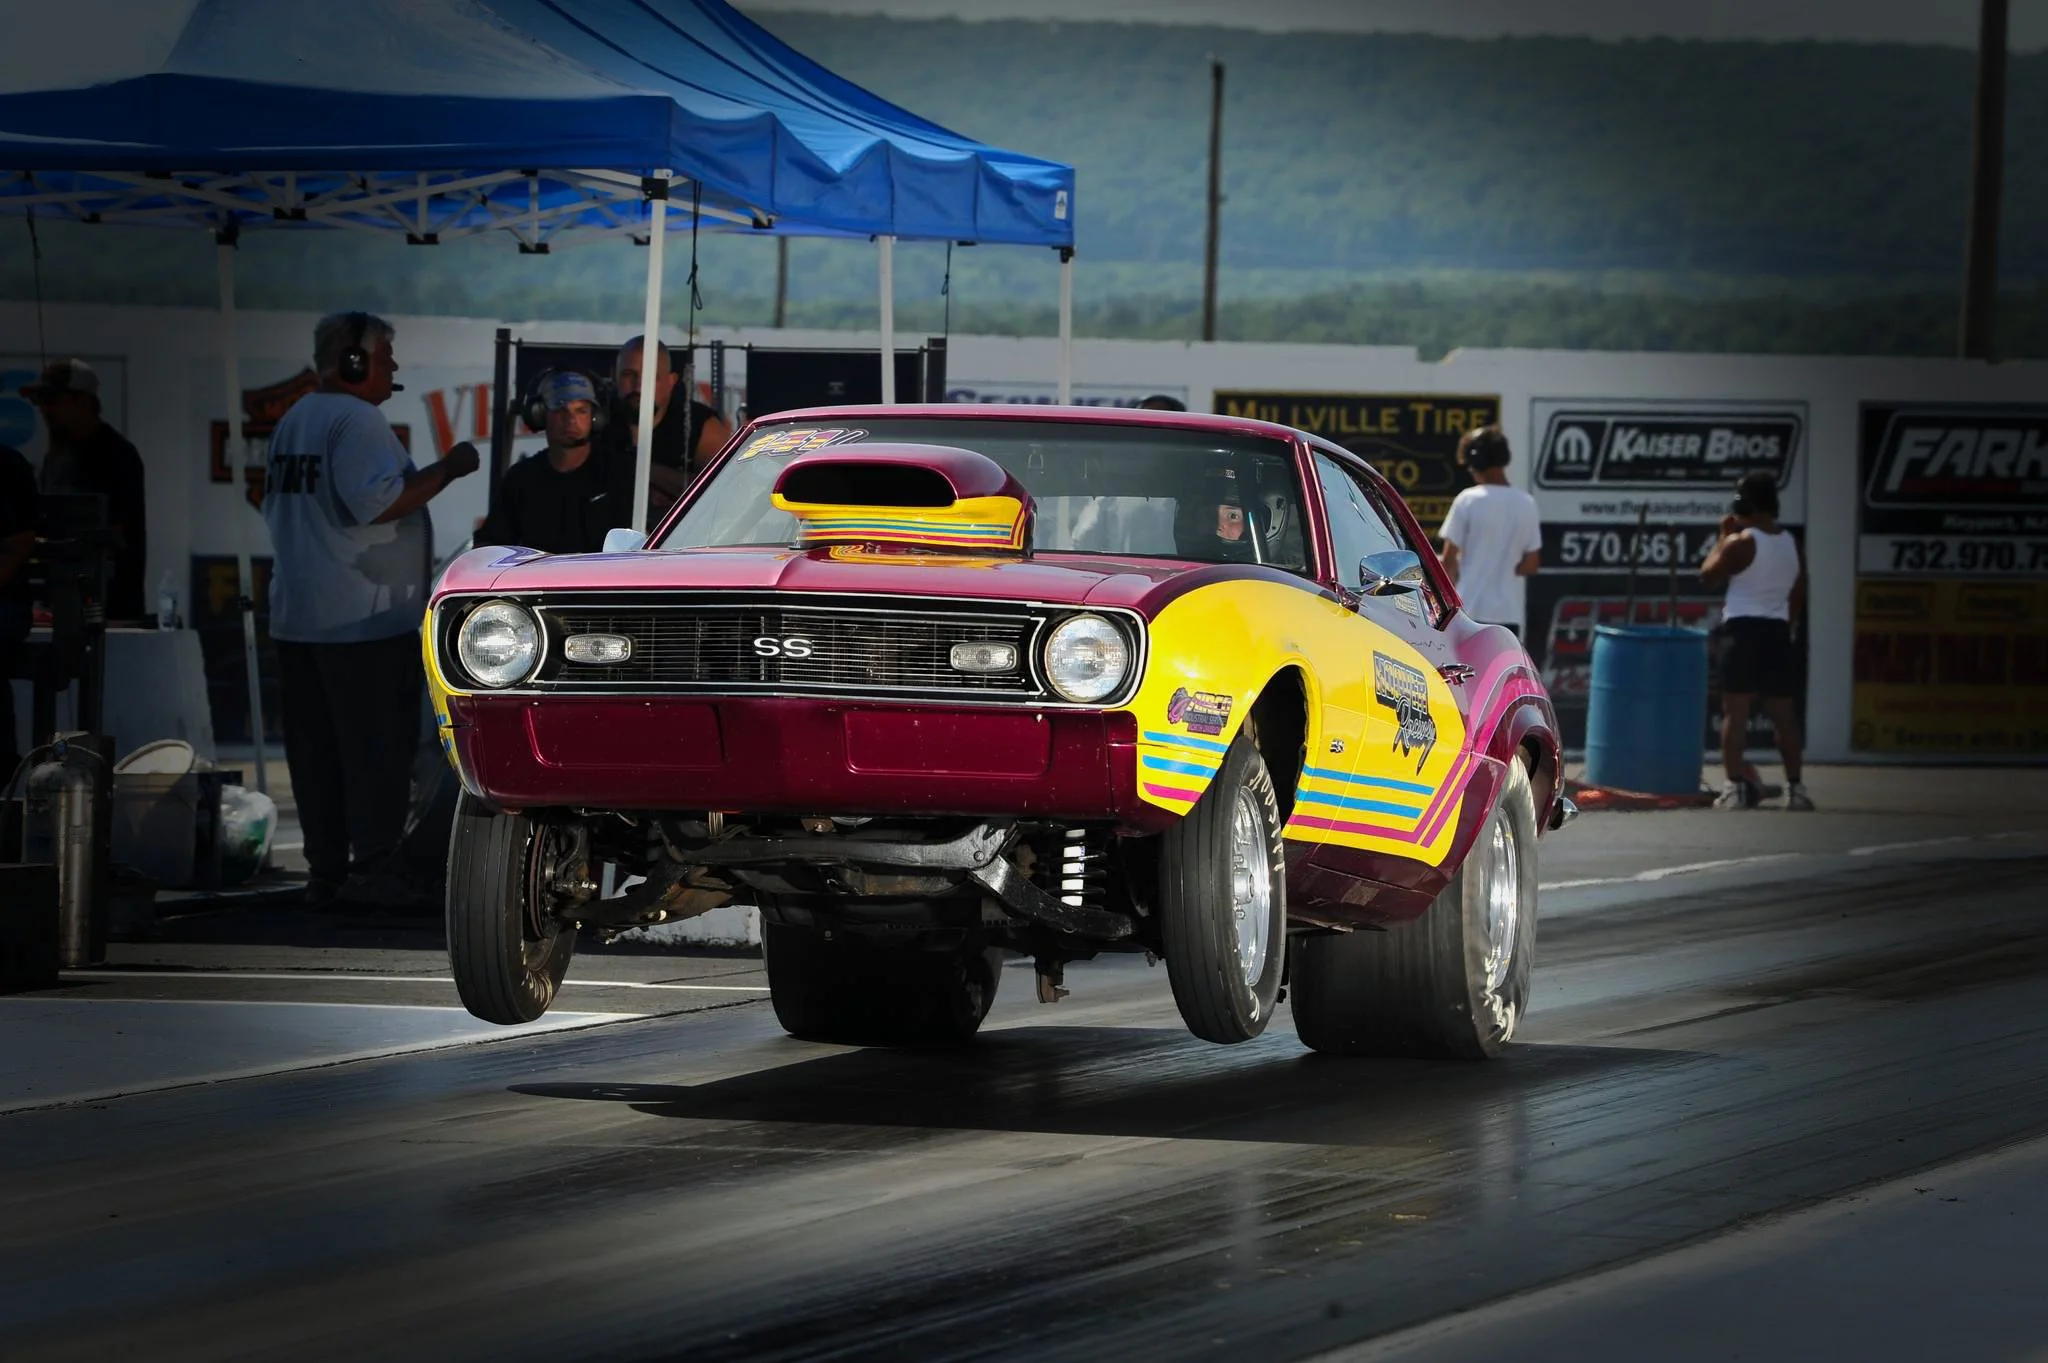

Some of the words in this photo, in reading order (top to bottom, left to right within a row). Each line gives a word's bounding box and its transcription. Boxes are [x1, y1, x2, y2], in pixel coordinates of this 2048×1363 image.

[1608, 427, 1702, 463] KAISER
[266, 455, 322, 494] TAFF
[753, 637, 812, 657] SS
